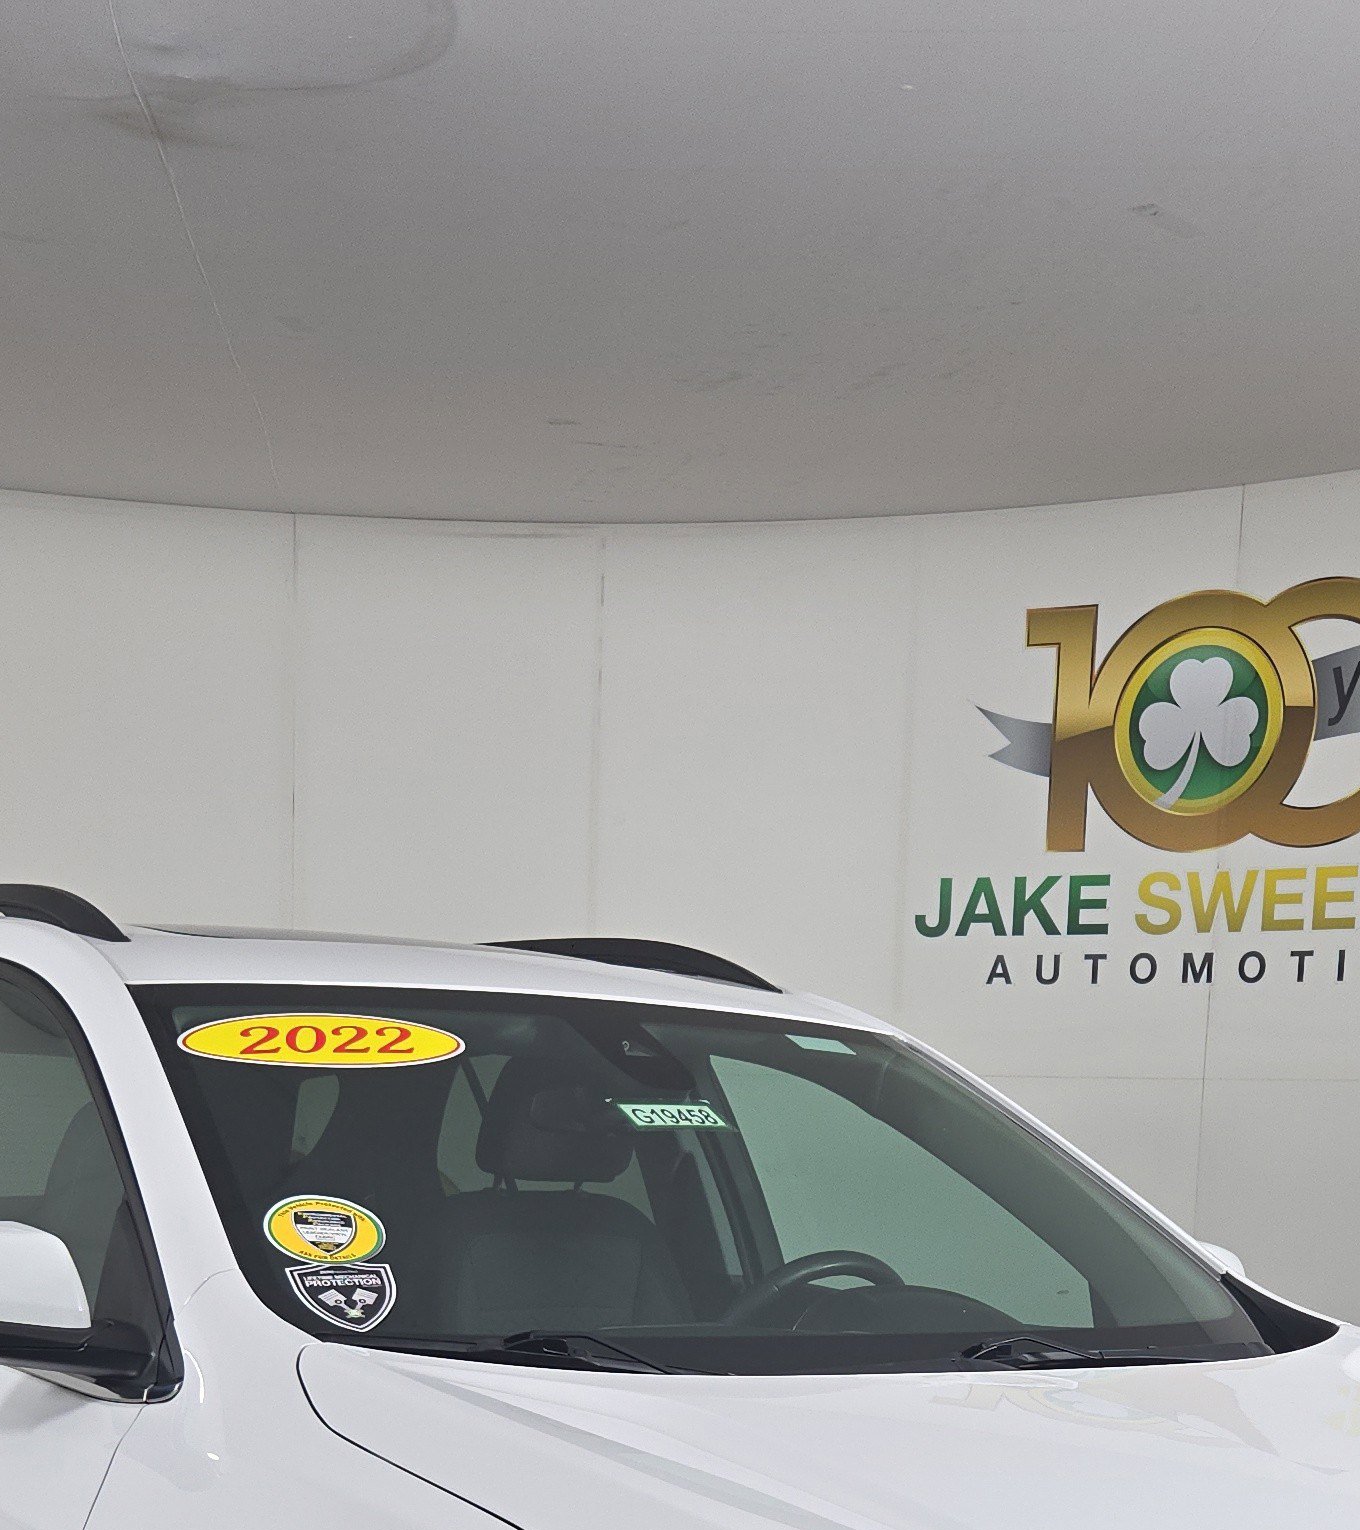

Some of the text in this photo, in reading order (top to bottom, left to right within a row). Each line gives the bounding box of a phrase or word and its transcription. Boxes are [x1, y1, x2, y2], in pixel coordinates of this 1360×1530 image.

[915, 874, 1111, 938] JAKE
[240, 1025, 415, 1054] 2022
[631, 1108, 719, 1125] G19458
[305, 1278, 382, 1287] PROTECTION
